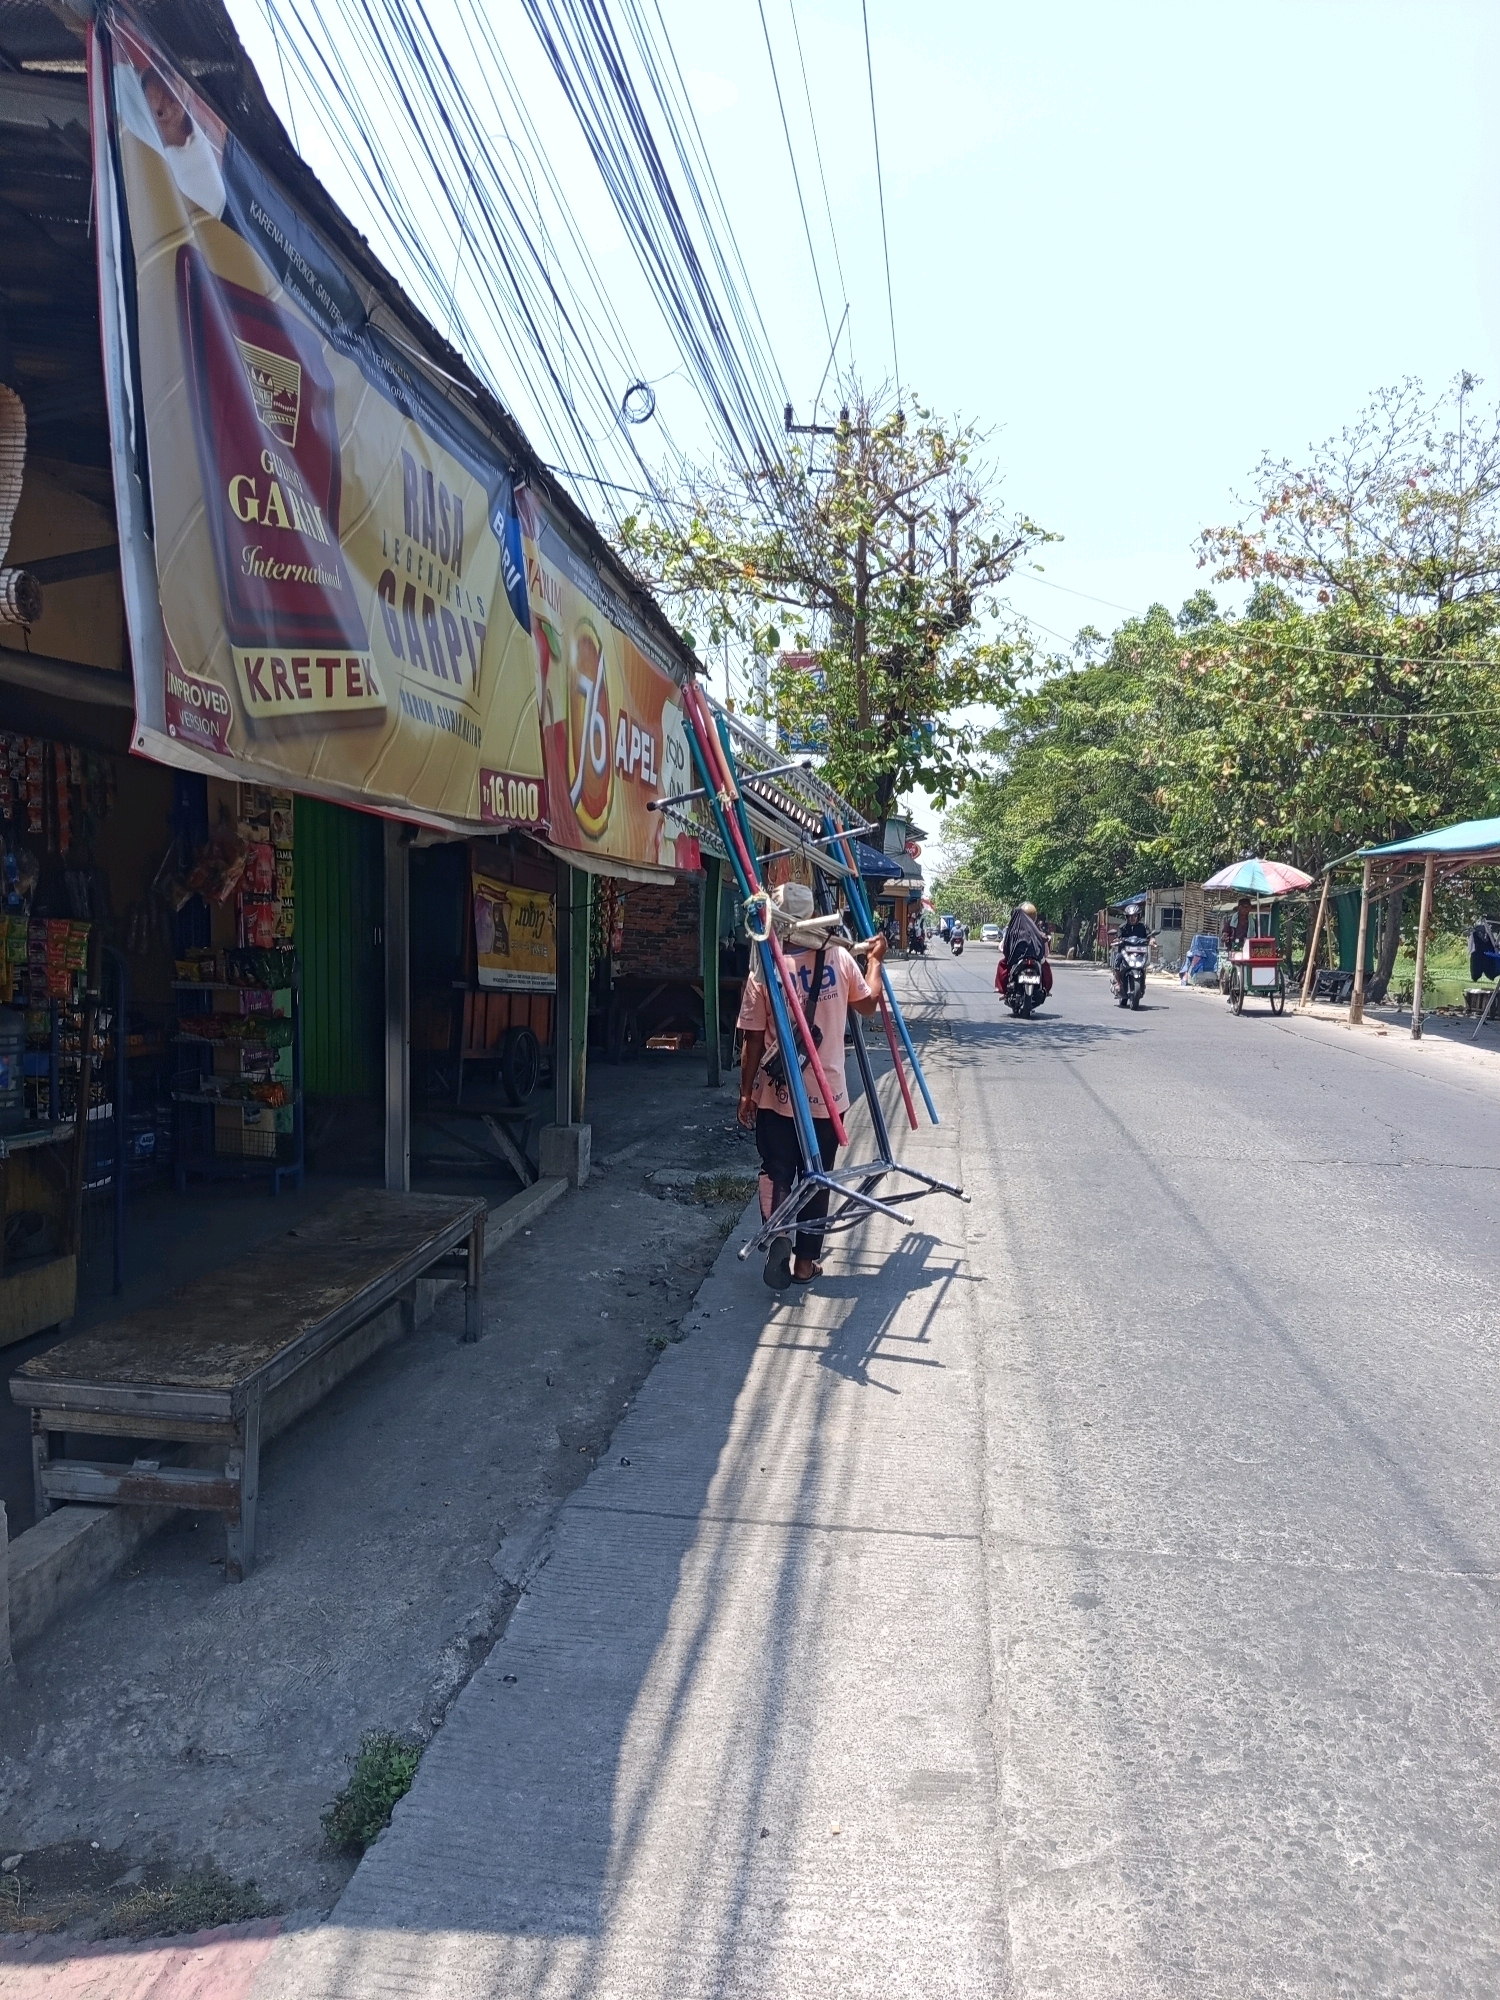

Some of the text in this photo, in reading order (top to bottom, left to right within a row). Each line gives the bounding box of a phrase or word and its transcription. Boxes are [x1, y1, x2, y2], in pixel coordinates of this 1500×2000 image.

[250, 200, 284, 248] KARENA
[315, 284, 334, 310] SAYA
[402, 446, 463, 579] RASA
[382, 530, 485, 619] LEGENDARIS
[167, 670, 229, 727] IMPROVED
[243, 656, 380, 704] KRETEK
[178, 709, 220, 738] VERSION
[615, 716, 658, 787] APEL
[514, 902, 545, 939] Cigar
